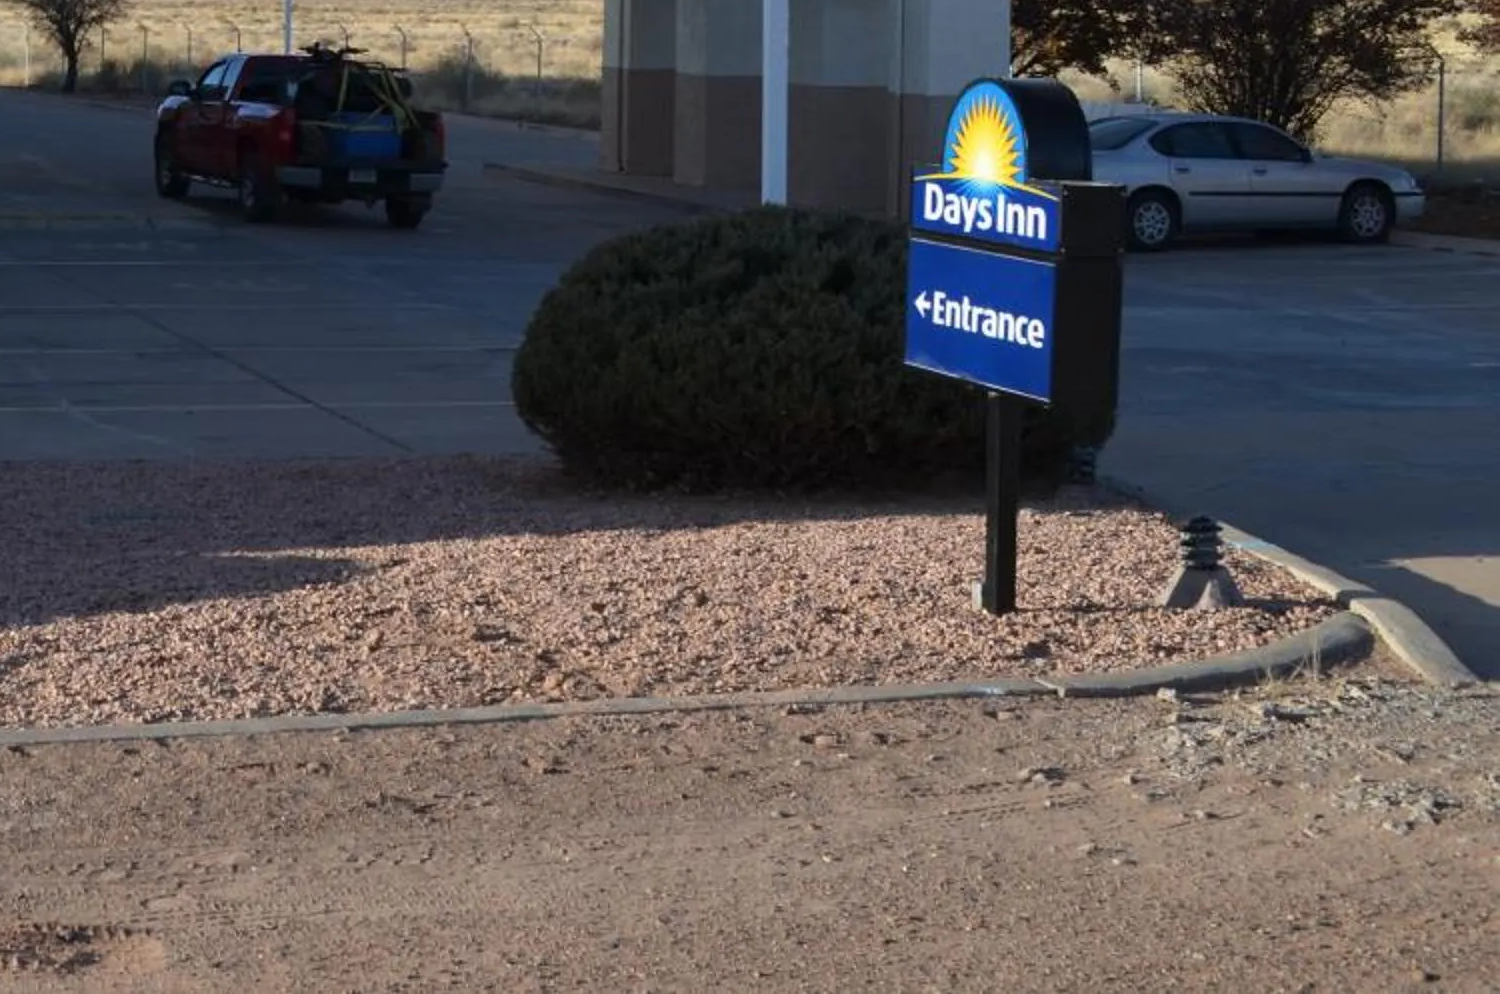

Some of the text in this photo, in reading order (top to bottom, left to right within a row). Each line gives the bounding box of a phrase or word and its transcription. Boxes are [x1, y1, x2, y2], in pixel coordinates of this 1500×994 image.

[923, 182, 1047, 240] Days Inn
[931, 291, 1045, 349] Entrance
